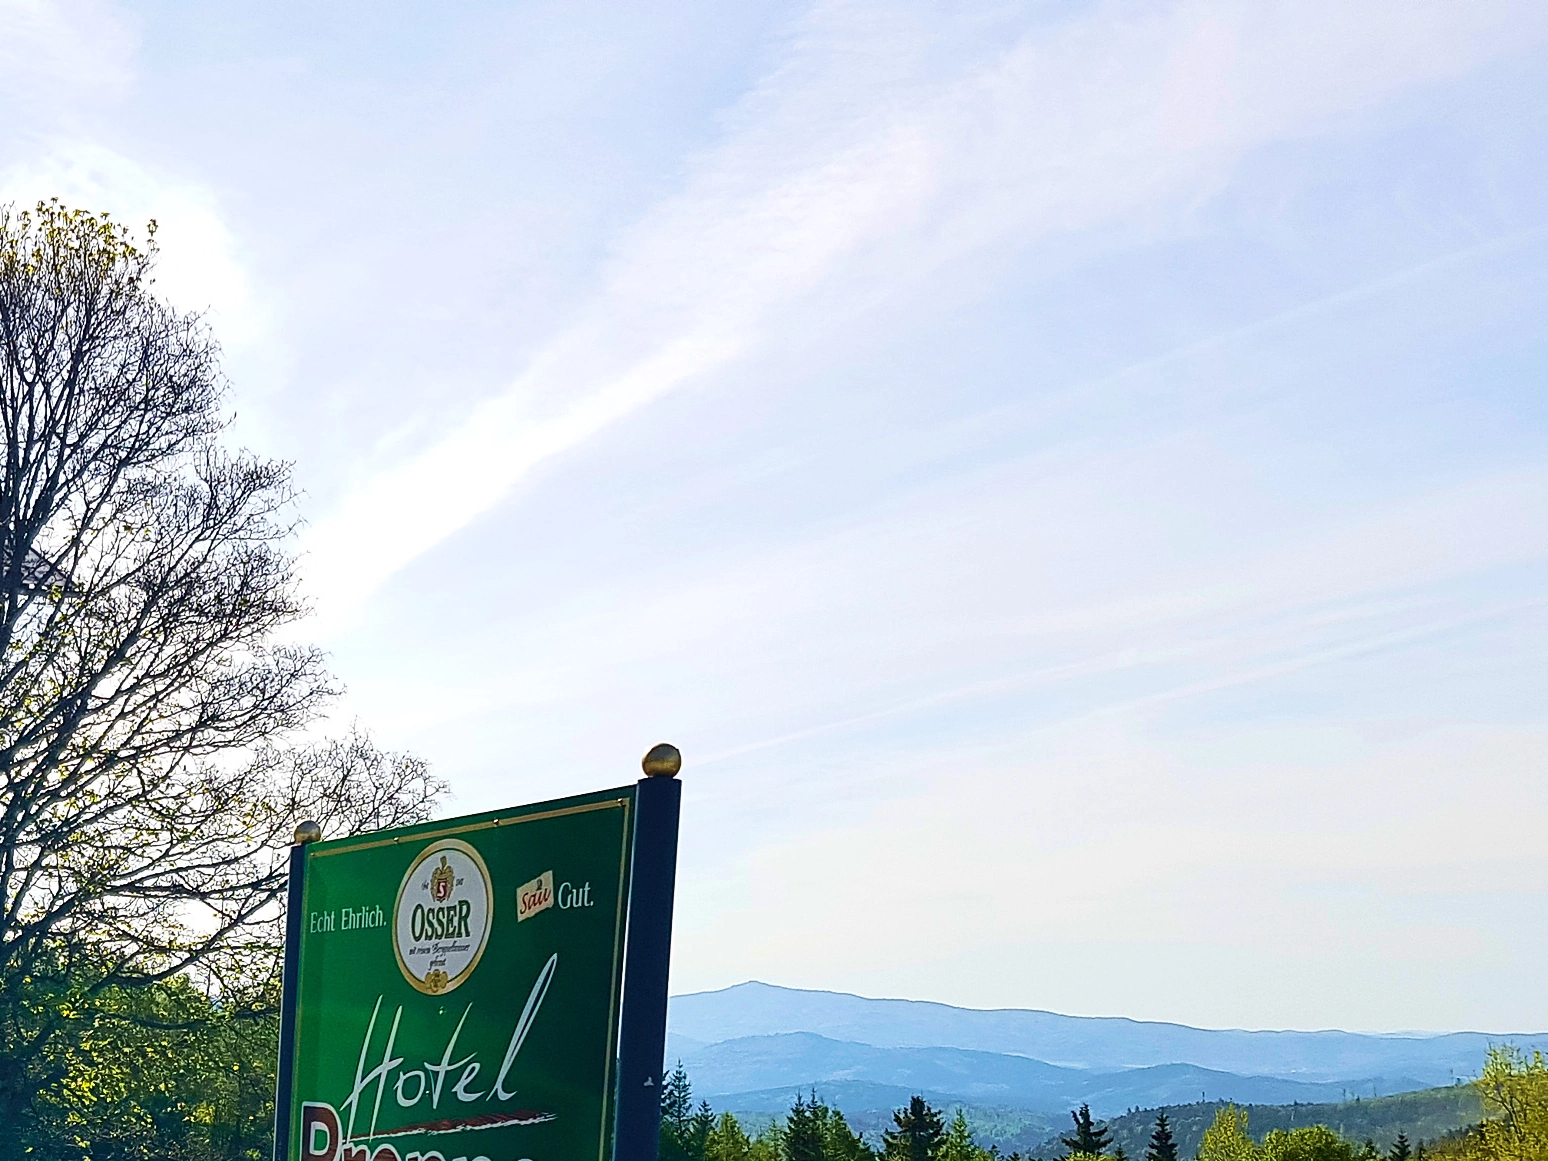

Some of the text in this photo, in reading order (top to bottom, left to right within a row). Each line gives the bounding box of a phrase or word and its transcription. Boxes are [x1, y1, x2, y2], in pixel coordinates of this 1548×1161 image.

[558, 882, 594, 909] Gut.
[310, 905, 387, 933] Echt Ehrlich.
[411, 900, 471, 942] OSSER
[339, 952, 557, 1144] Hotel
